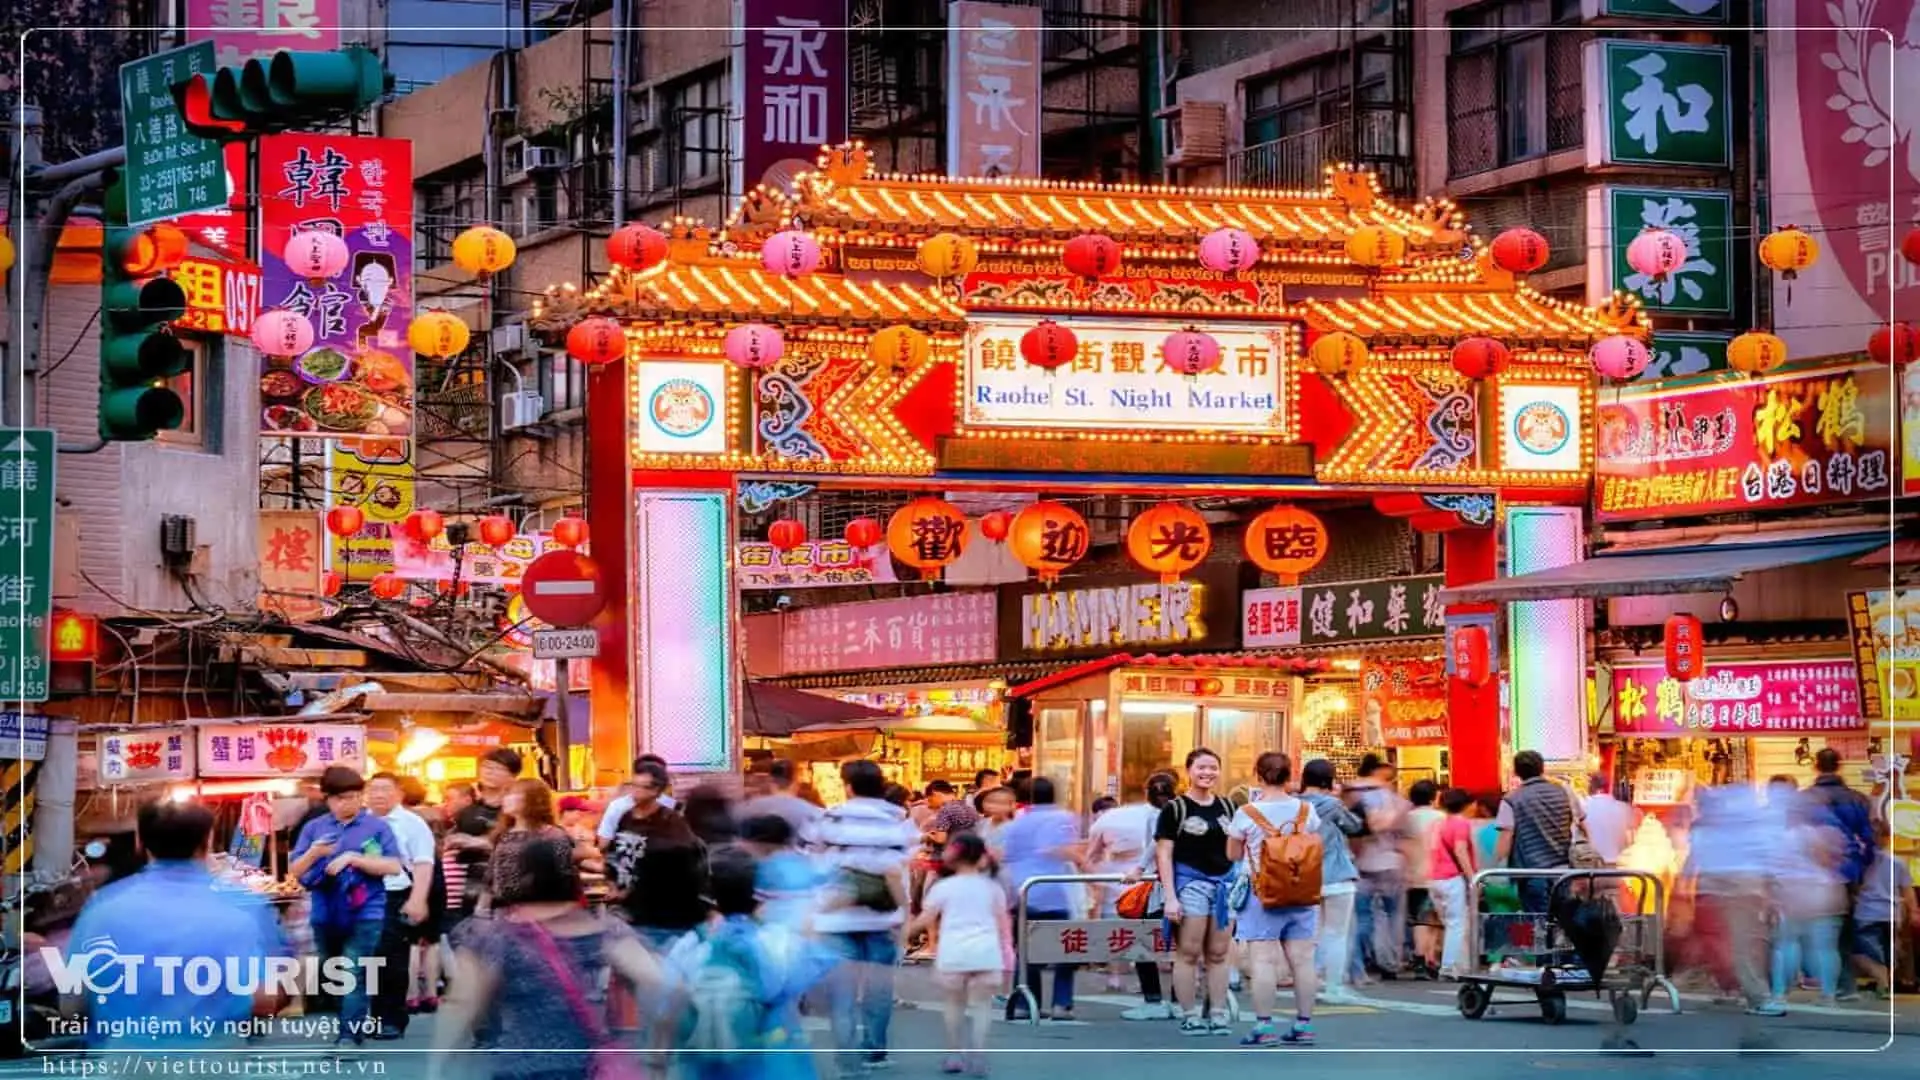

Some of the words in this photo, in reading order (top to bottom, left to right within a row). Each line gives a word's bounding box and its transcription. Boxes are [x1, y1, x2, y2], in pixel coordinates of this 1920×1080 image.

[764, 17, 828, 145] 永和
[976, 384, 1048, 406] Raohe
[1064, 387, 1094, 408] St.
[1110, 387, 1172, 412] Night
[1189, 385, 1275, 411] Market
[1151, 521, 1205, 561] 光
[1264, 523, 1318, 560] 臨
